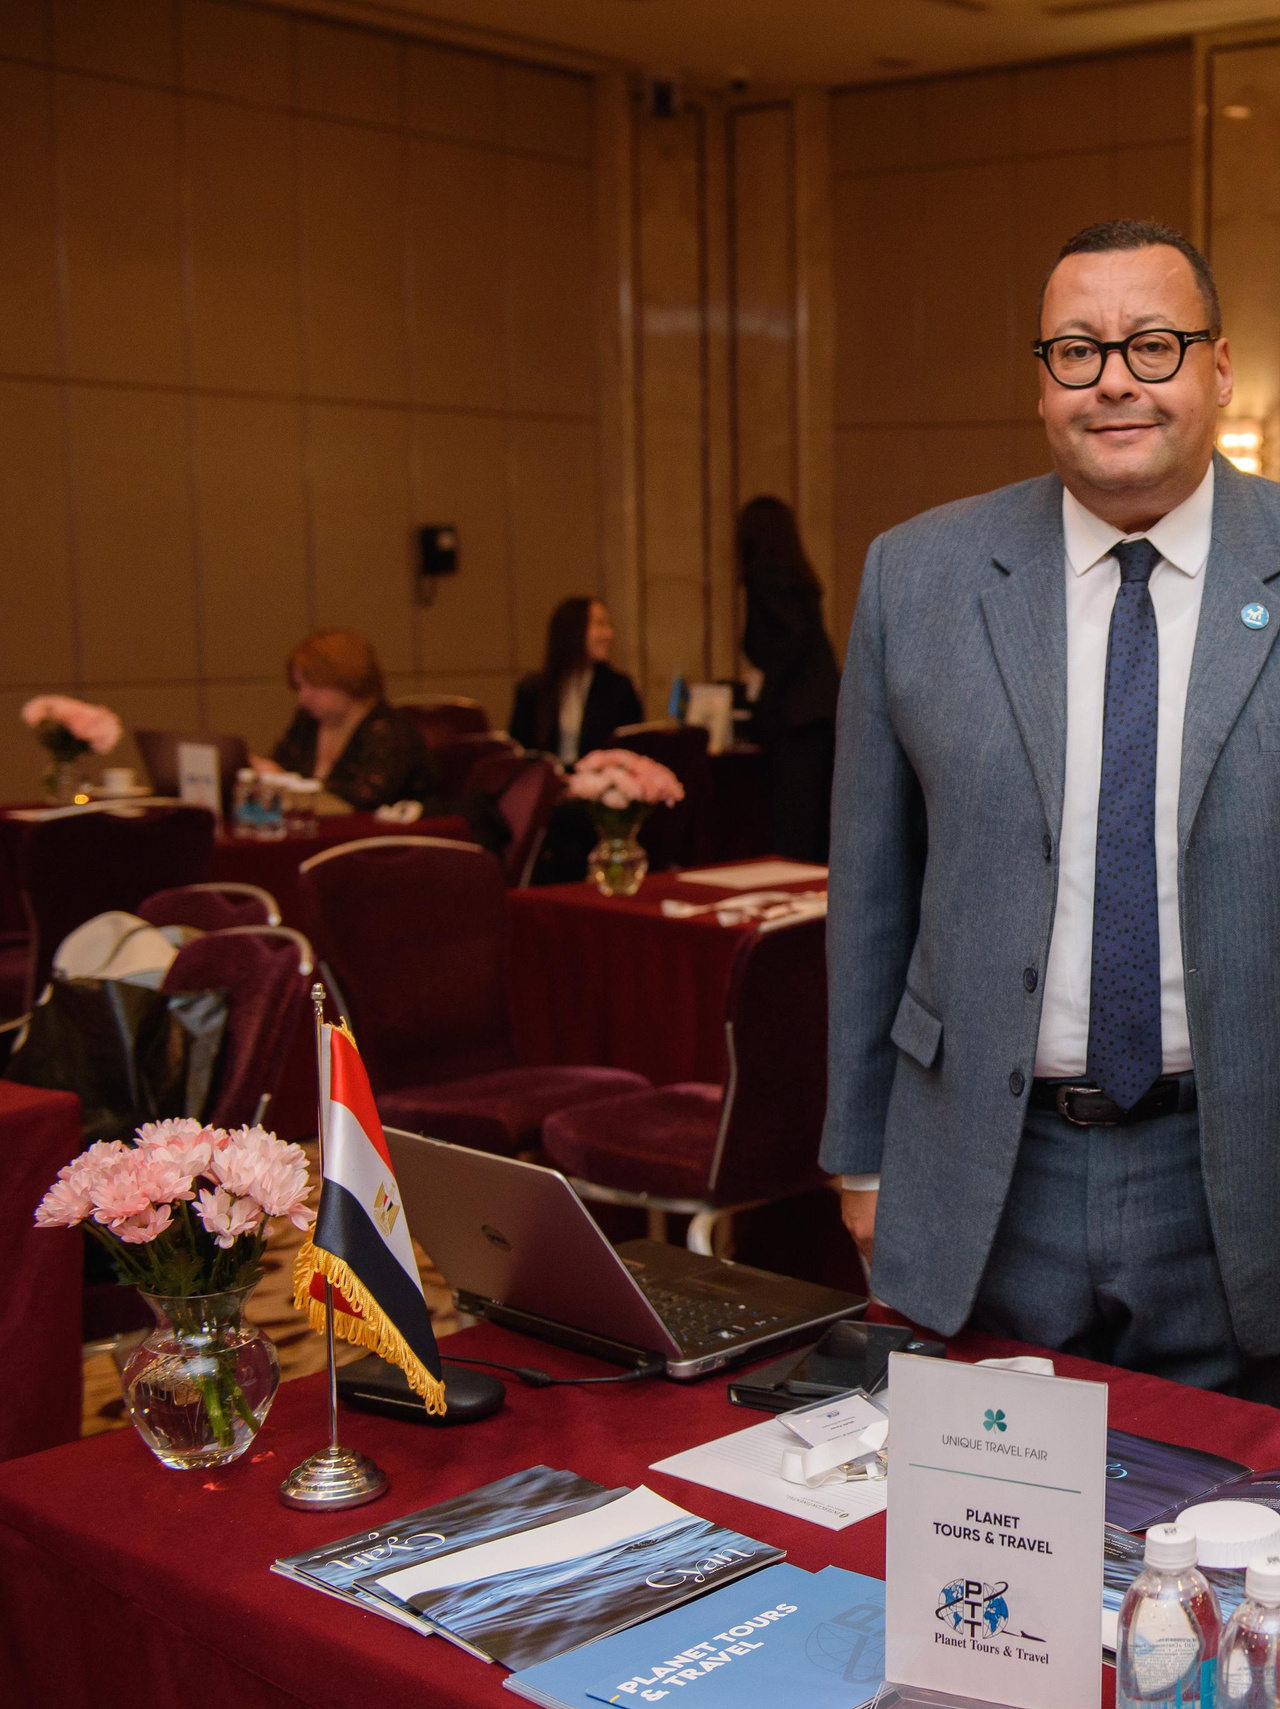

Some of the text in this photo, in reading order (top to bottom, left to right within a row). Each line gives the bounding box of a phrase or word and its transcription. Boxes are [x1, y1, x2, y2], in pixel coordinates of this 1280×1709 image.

[942, 1433, 1048, 1461] UNIQUE TRAVEL FAIR
[965, 1508, 1020, 1530] PLANET
[933, 1521, 1053, 1555] TOURS & TRAVEL
[645, 1548, 756, 1589] Cyan
[616, 1602, 799, 1695] PLANET TOURS
[934, 1632, 1049, 1664] Planet Tours & Travel
[640, 1638, 765, 1702] & TRAVEL
